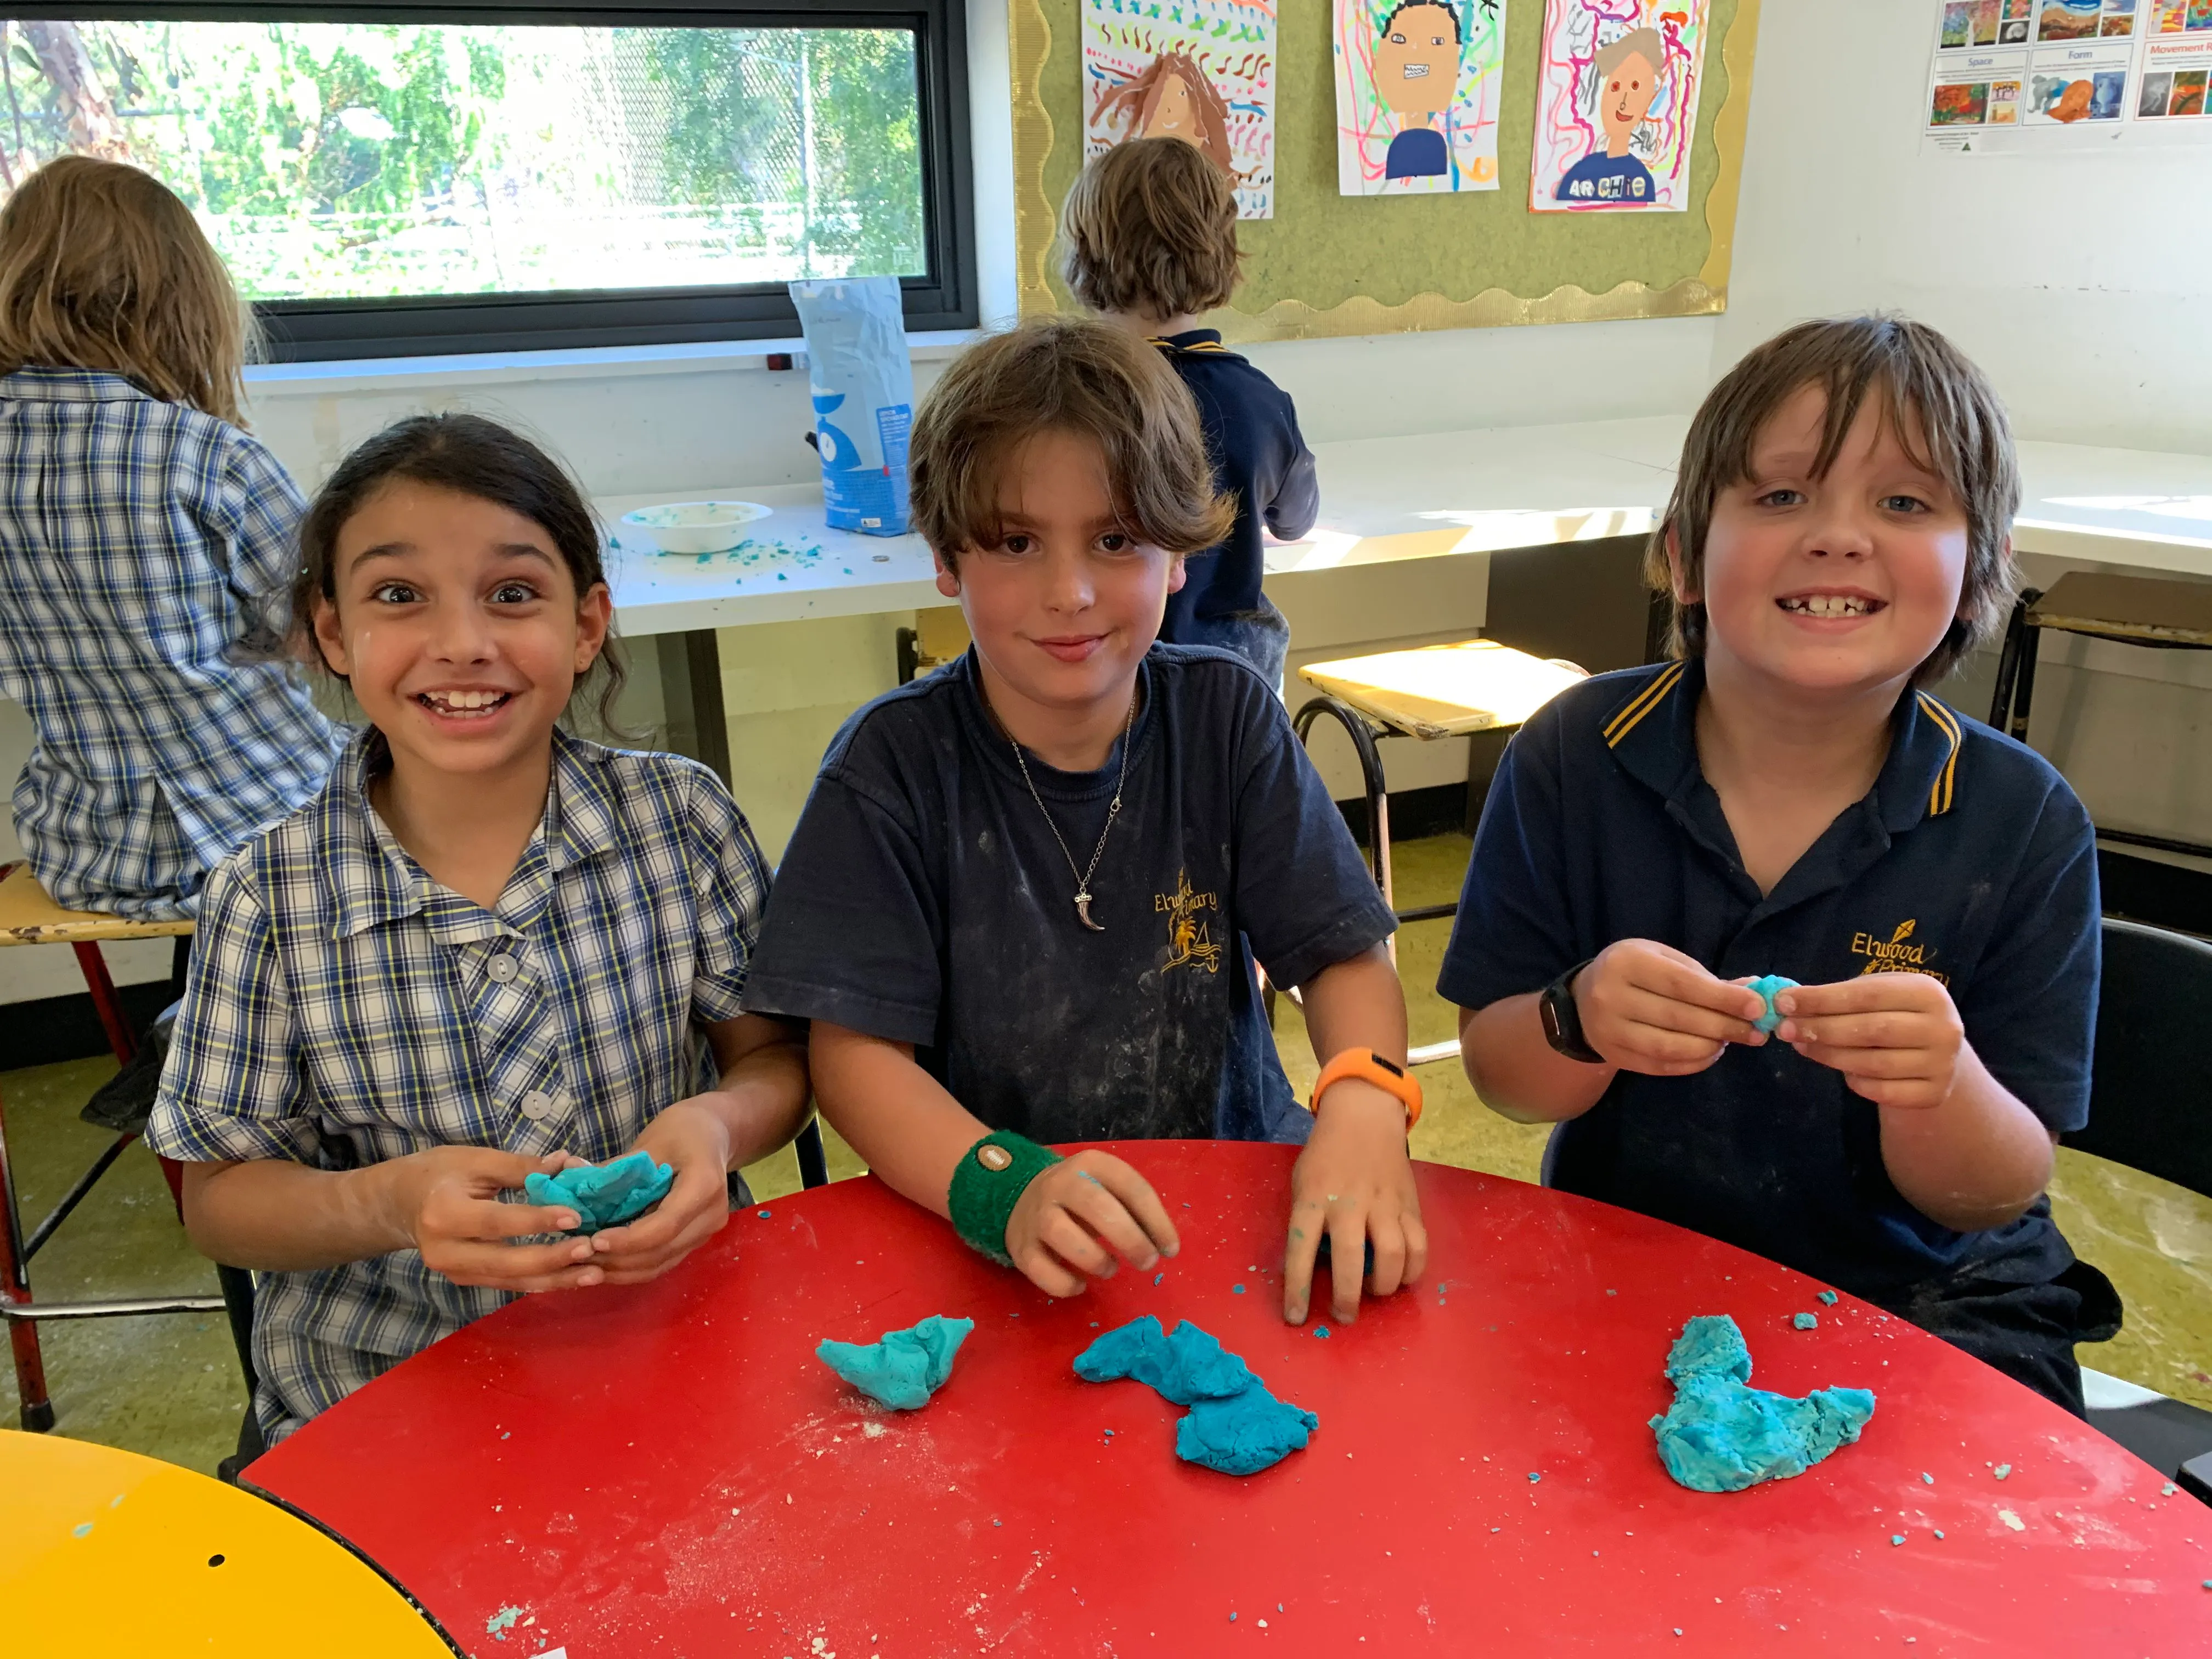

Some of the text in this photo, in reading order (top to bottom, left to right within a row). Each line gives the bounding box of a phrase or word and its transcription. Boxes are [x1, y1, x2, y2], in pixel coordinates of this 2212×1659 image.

[2151, 44, 2204, 54] Movement
[2068, 50, 2093, 59] Form
[1968, 58, 1994, 67] Space
[1852, 932, 1925, 965] Elwood
